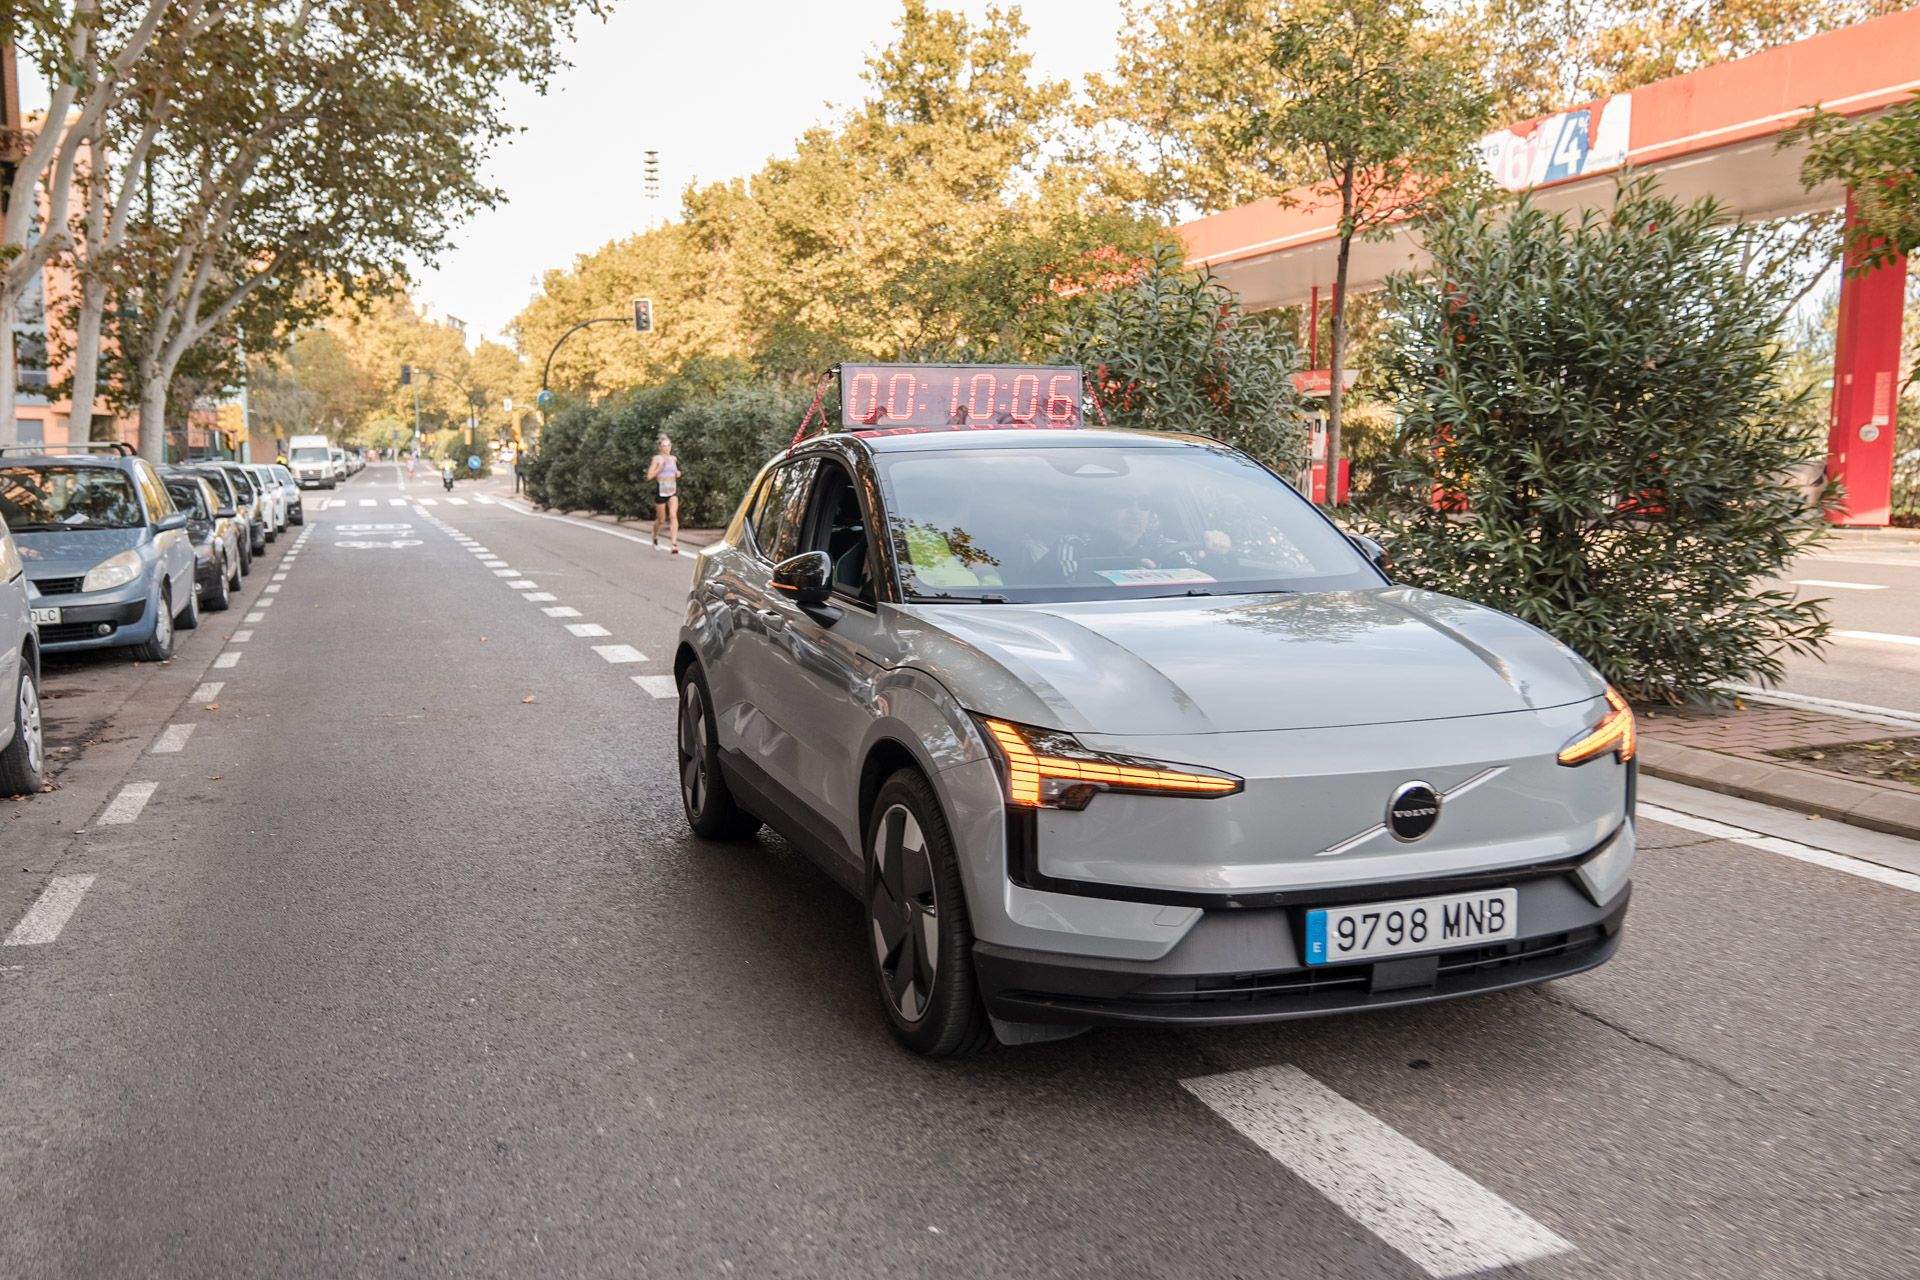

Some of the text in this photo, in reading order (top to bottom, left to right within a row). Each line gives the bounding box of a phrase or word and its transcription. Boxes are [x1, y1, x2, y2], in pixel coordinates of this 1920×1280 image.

[1393, 807, 1437, 818] VOLVO
[1337, 898, 1505, 952] 9798 MNB
[1313, 942, 1321, 952] E
